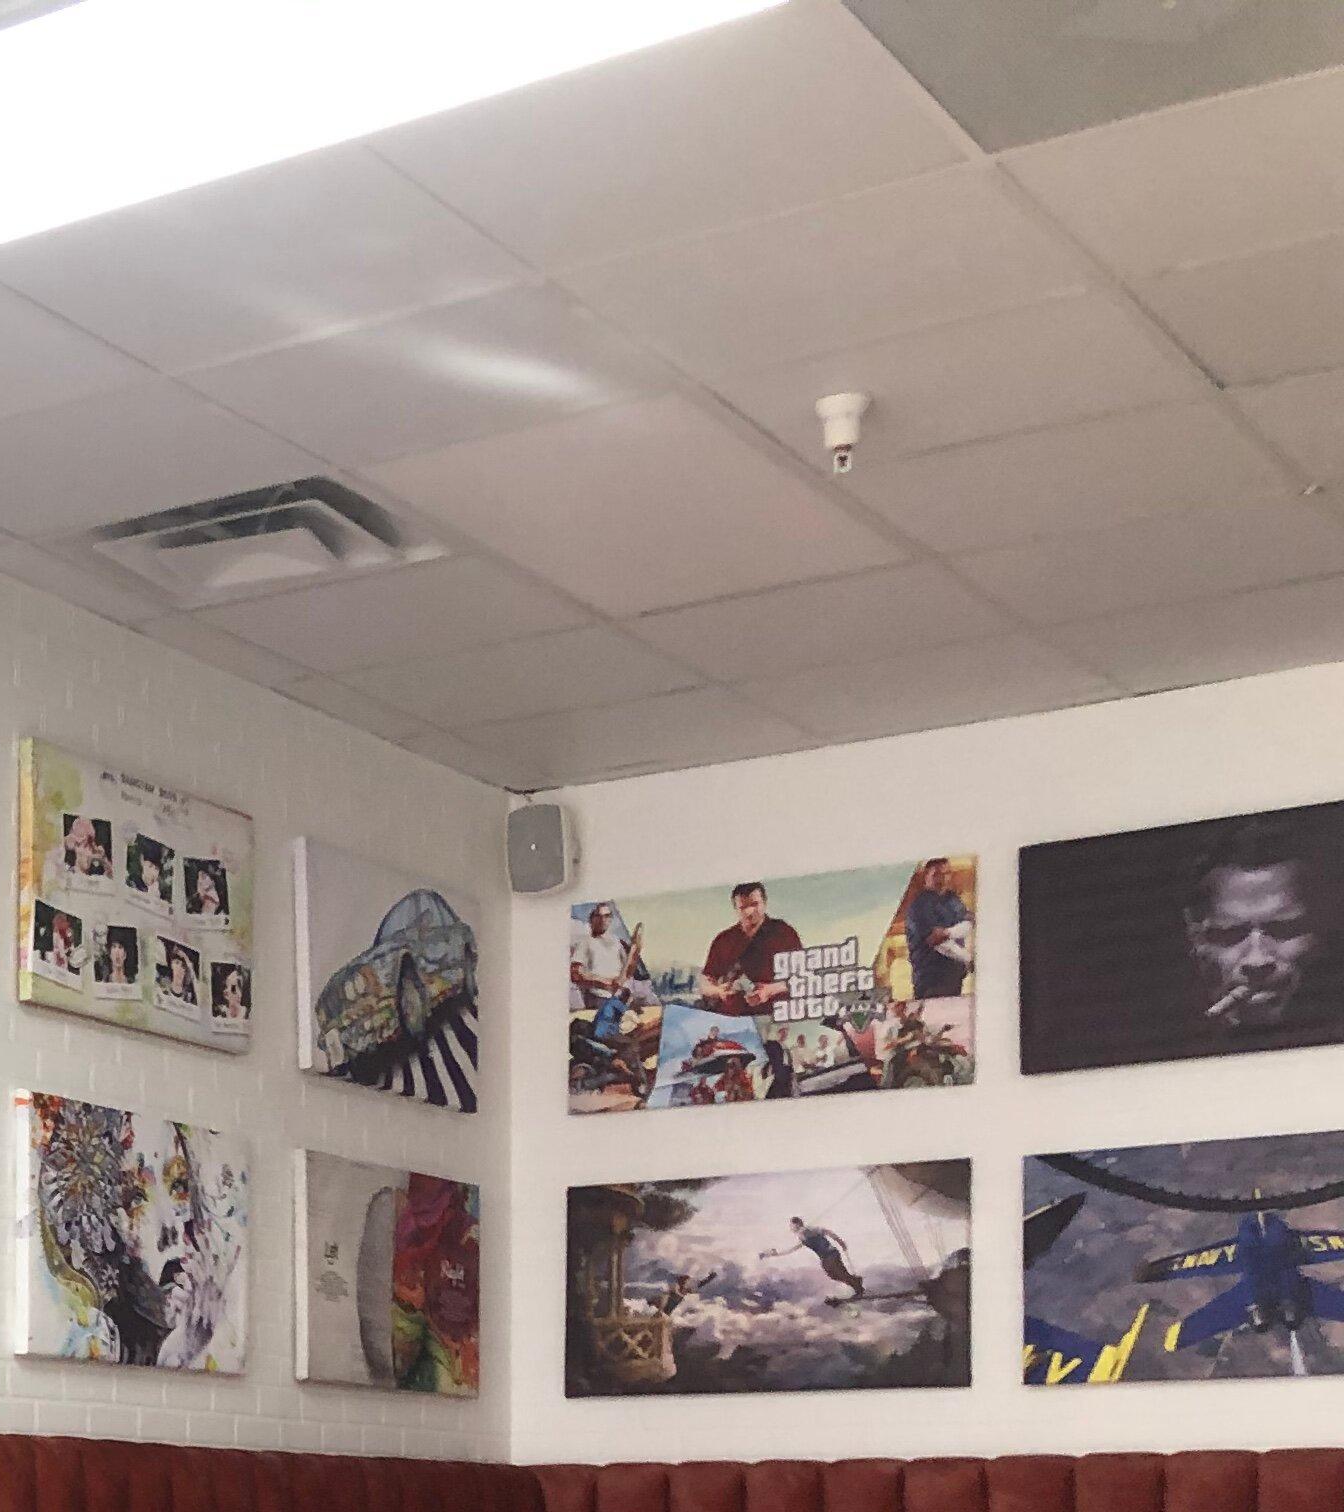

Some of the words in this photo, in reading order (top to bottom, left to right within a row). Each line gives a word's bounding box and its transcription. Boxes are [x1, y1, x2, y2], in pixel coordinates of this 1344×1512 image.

[772, 936, 859, 981] grand
[788, 968, 874, 998] theft
[772, 996, 840, 1022] auto
